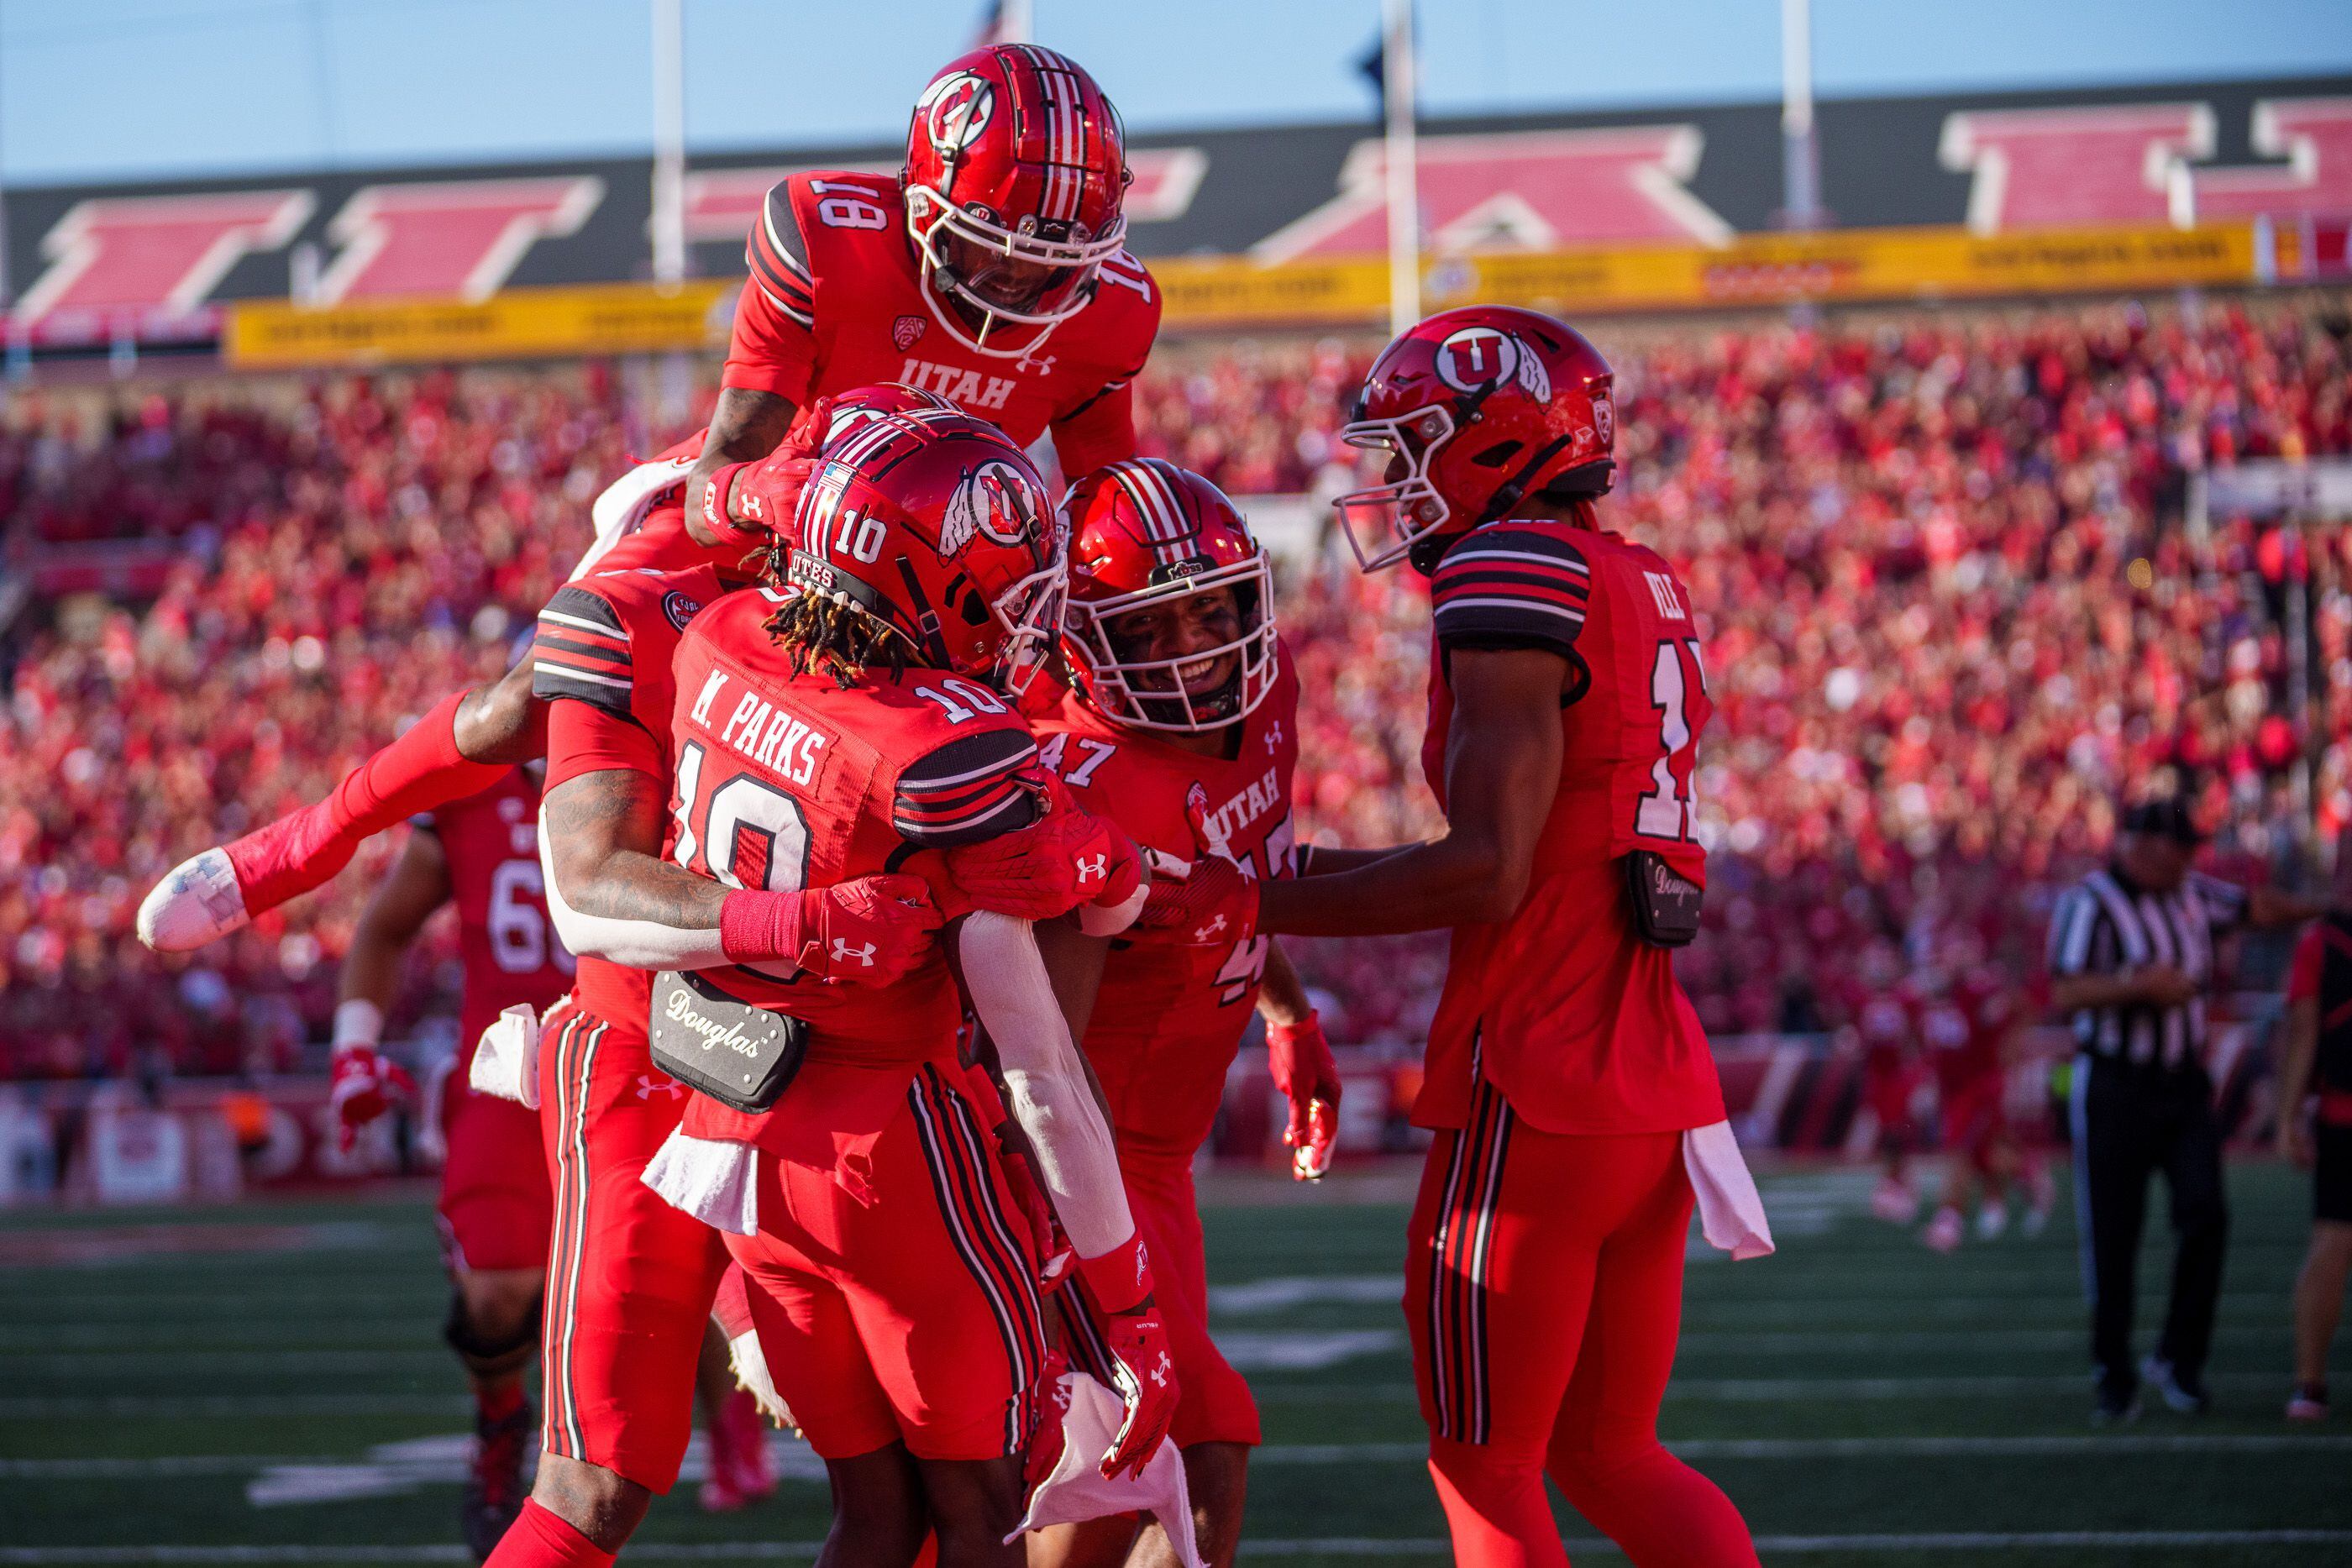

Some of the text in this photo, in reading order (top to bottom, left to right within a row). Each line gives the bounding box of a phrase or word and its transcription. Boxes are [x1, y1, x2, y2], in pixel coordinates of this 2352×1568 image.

[808, 179, 888, 231] 18
[898, 358, 1016, 410] UTAH
[1447, 336, 1502, 386] U
[834, 508, 887, 564] 10
[792, 554, 837, 589] UTES
[690, 669, 827, 786] M. PARKS
[913, 678, 1008, 725] 10
[1038, 732, 1117, 788] 47
[1633, 636, 1706, 843] 1
[1207, 766, 1281, 842] UTAH
[673, 738, 813, 985] 10
